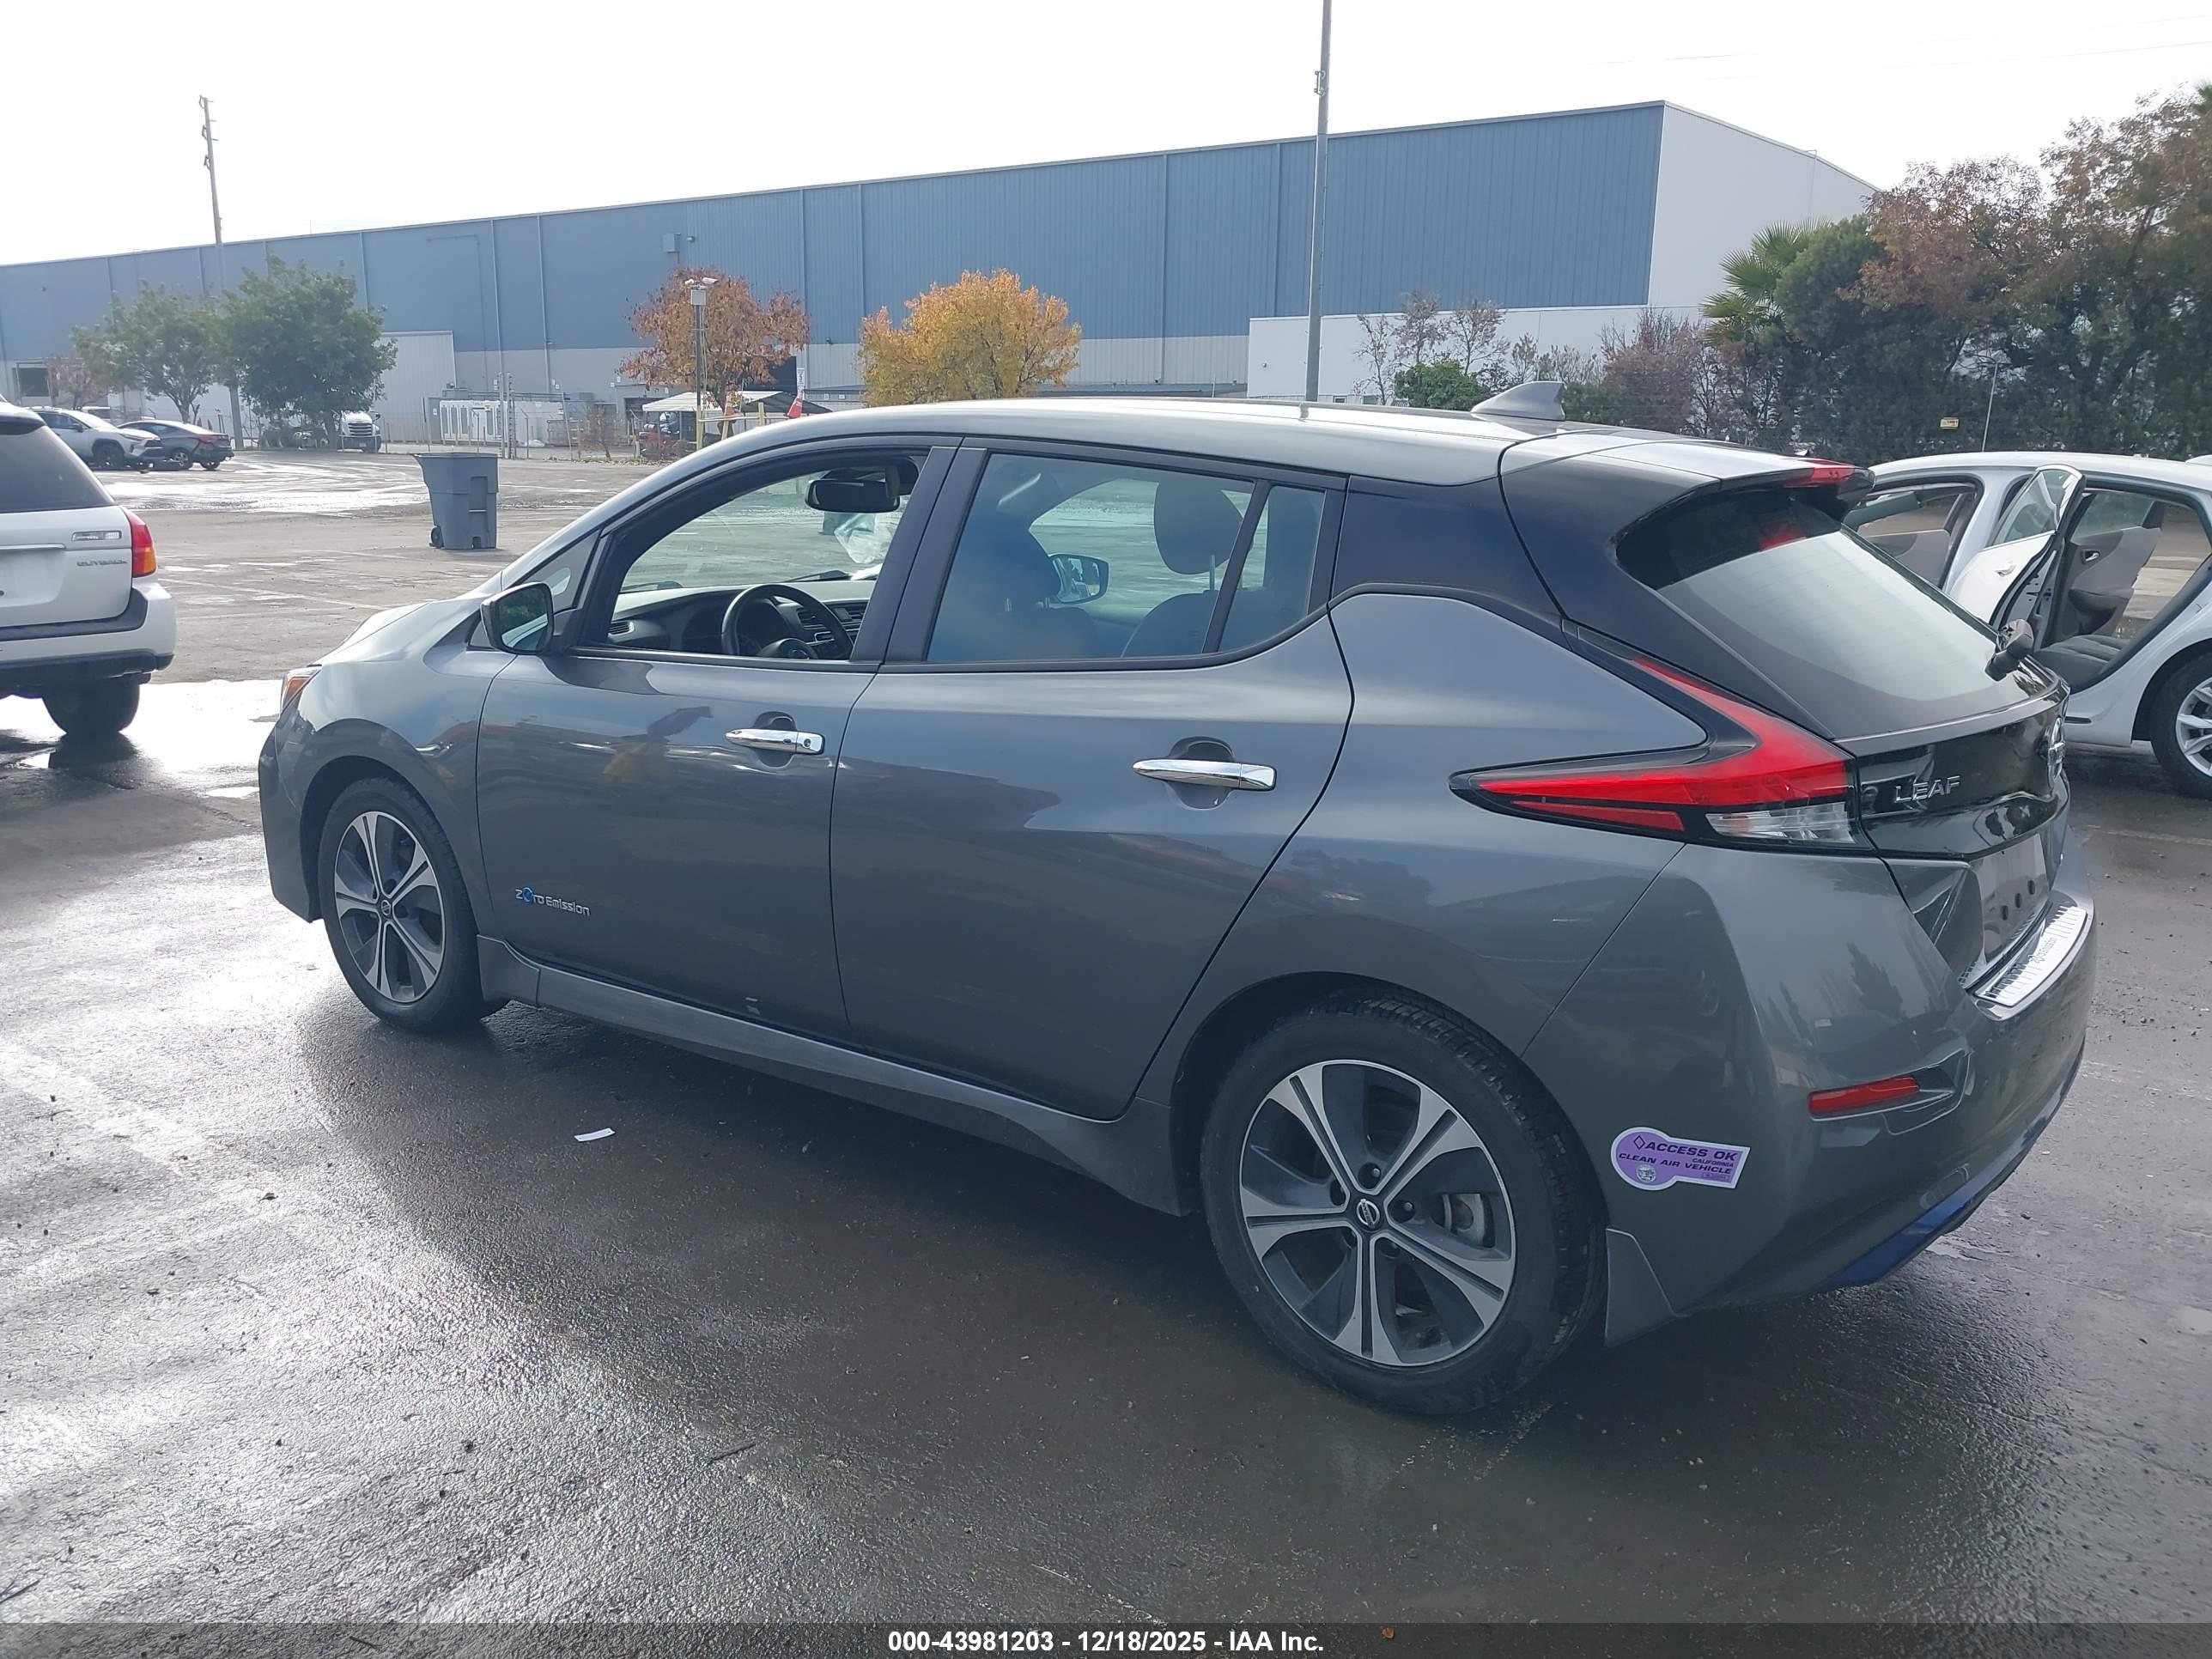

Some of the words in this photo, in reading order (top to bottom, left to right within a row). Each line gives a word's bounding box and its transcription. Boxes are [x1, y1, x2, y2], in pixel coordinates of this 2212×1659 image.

[1894, 775, 1960, 803] LEAF
[1644, 1141, 1708, 1158] ACCESS
[1714, 1151, 1738, 1161] OK
[1619, 1153, 1656, 1164] CLEAN
[1685, 1164, 1732, 1174] VEHICLE
[1692, 1158, 1734, 1168] CALIFORNIA
